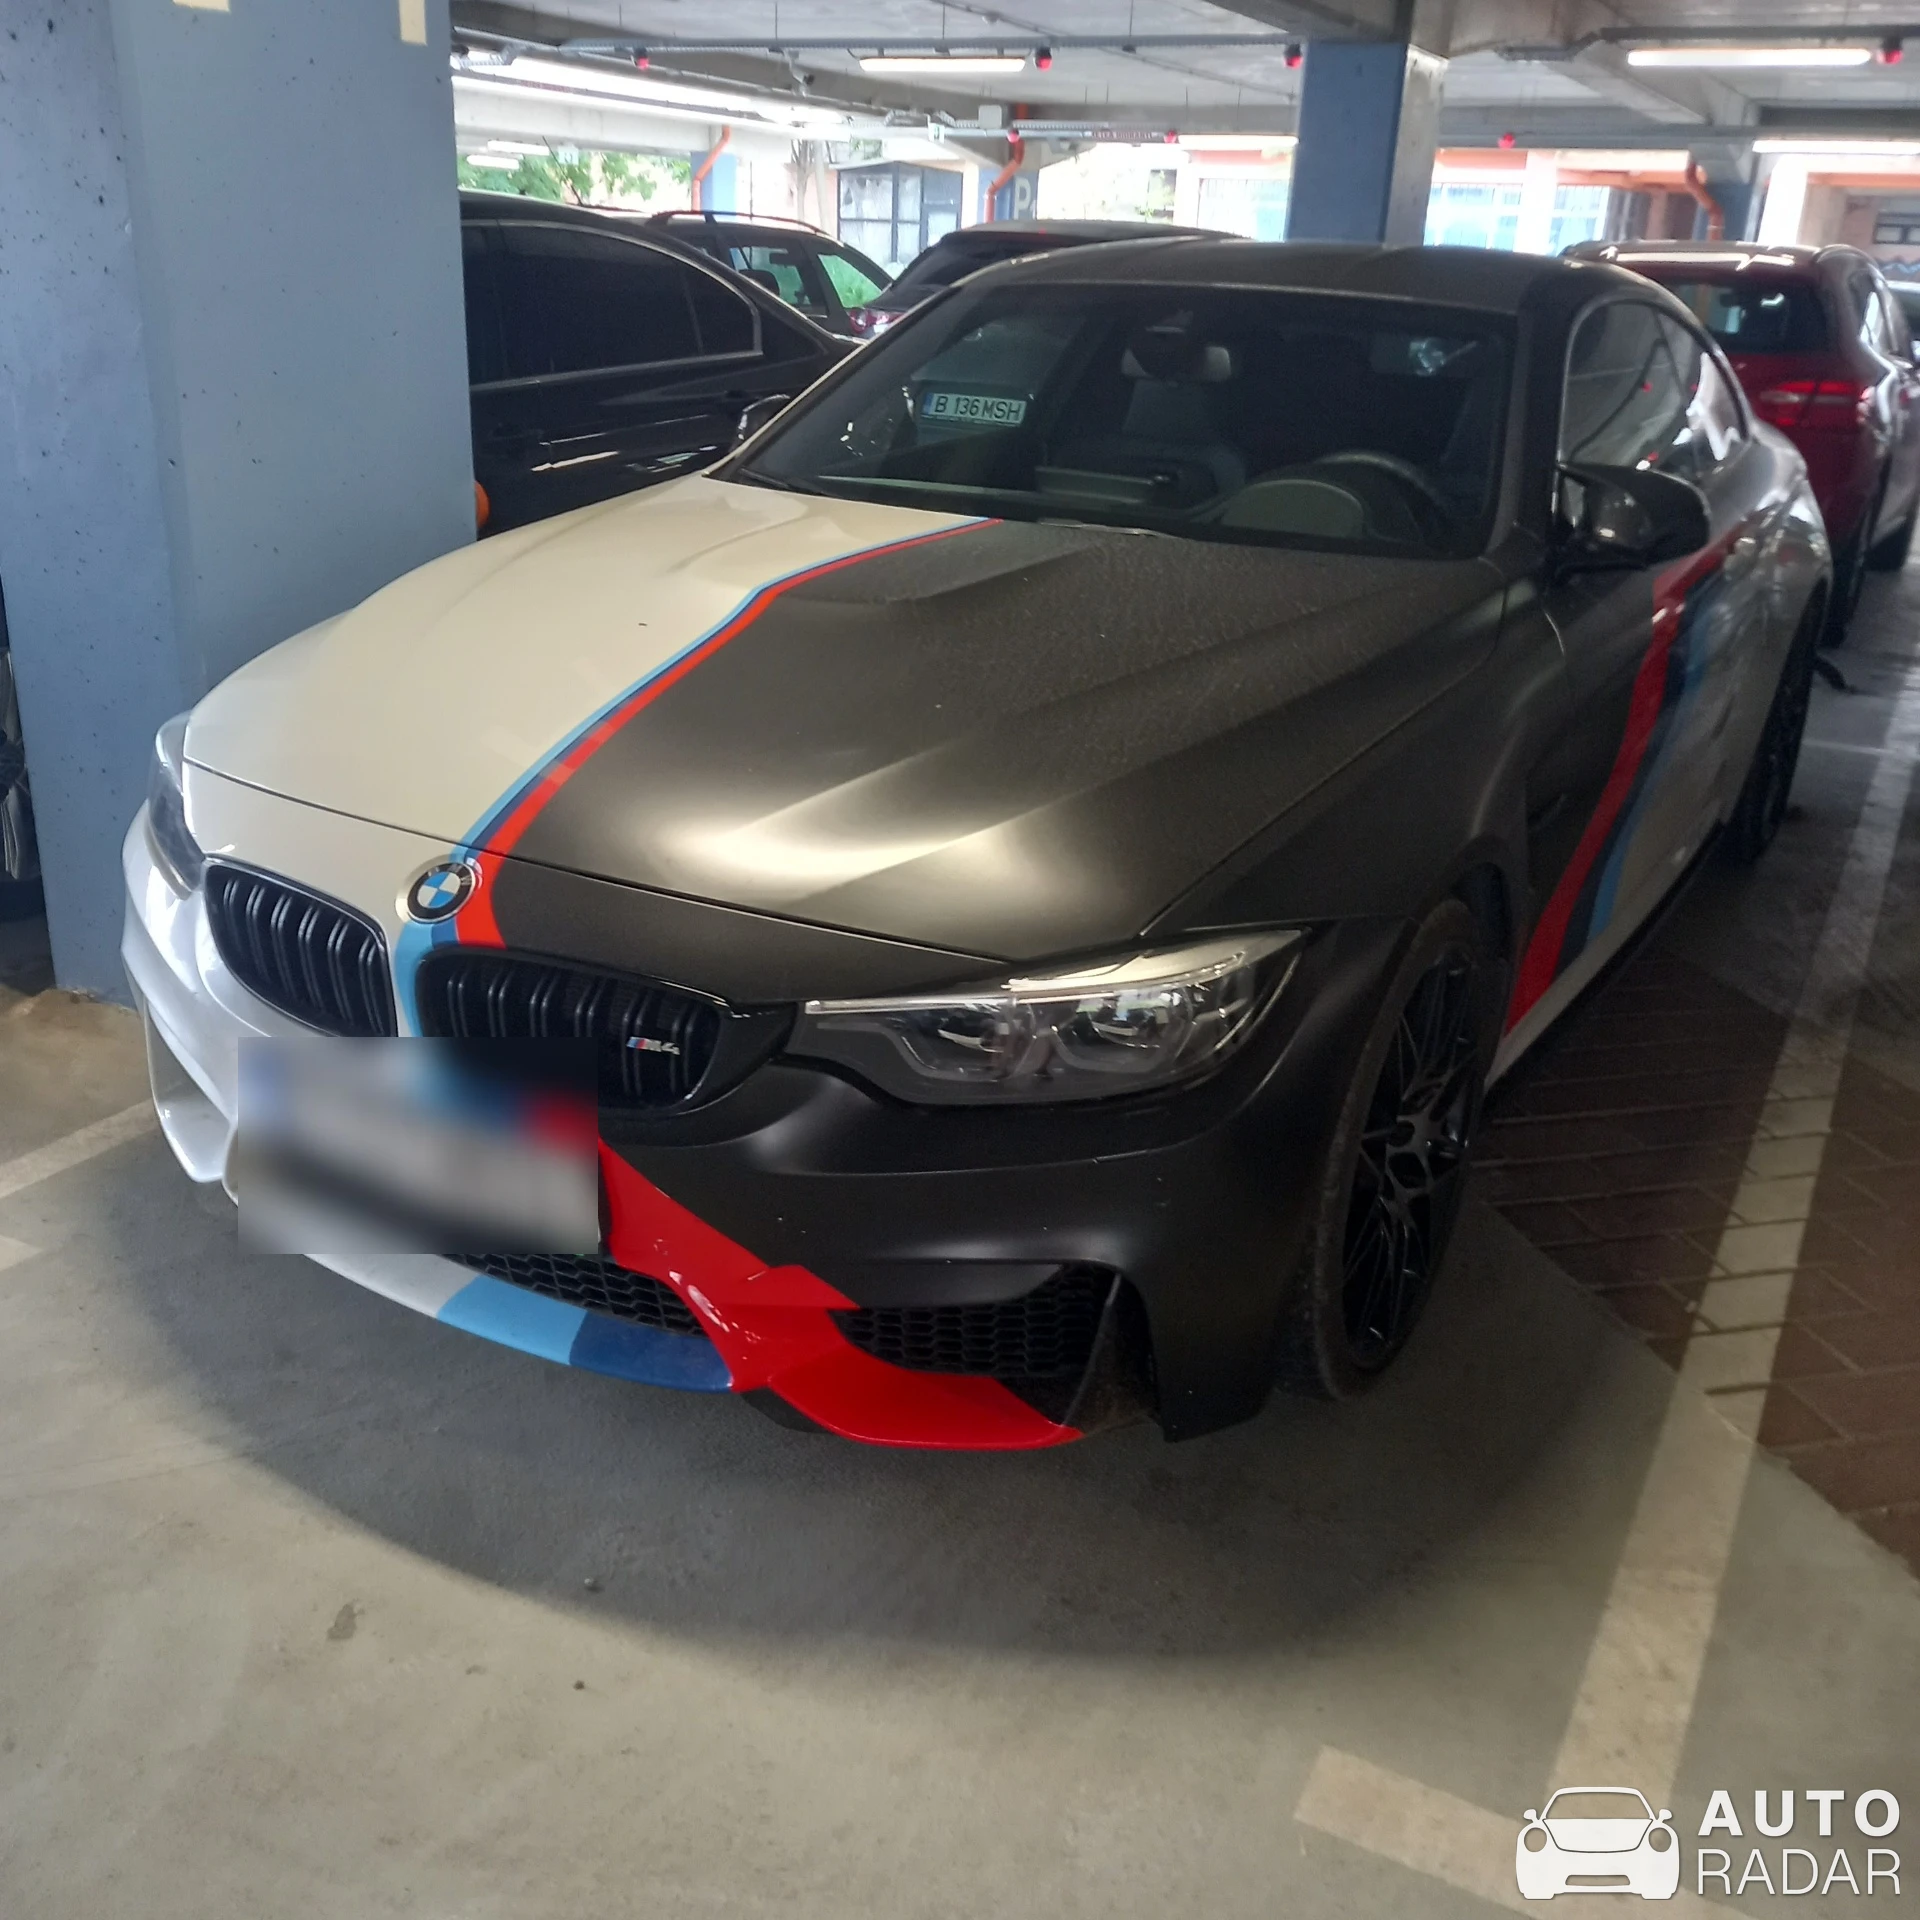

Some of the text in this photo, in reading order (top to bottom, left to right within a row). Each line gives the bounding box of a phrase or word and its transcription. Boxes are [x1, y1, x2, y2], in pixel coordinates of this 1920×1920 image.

[935, 396, 1021, 420] B 136 MSH
